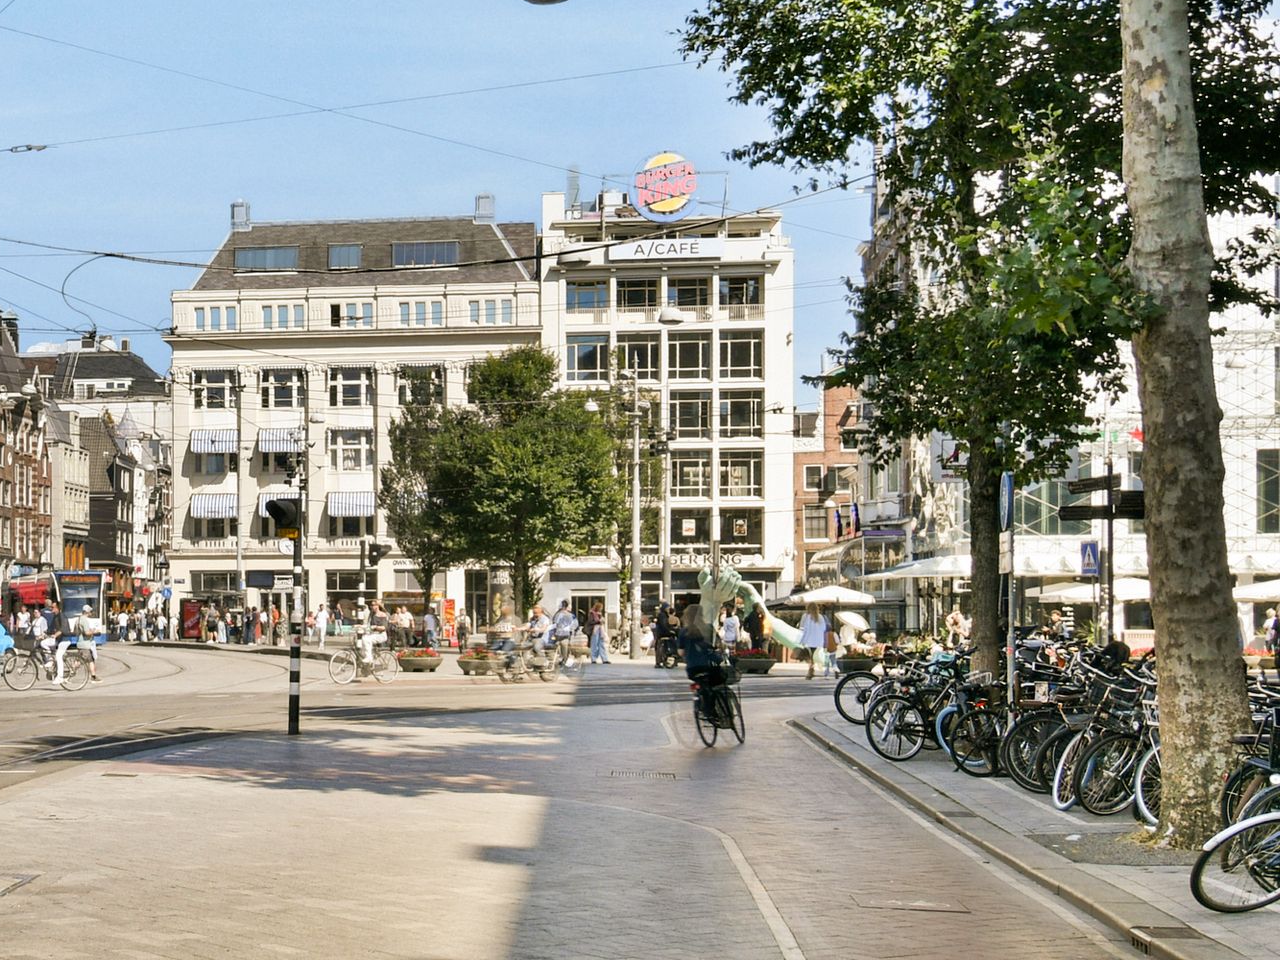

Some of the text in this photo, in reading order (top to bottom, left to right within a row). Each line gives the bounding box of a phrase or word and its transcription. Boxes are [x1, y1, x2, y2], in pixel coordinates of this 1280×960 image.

[635, 161, 695, 188] BURGER
[637, 174, 697, 208] KING
[634, 240, 699, 257] A/CAFÉ
[703, 553, 742, 565] KNG
